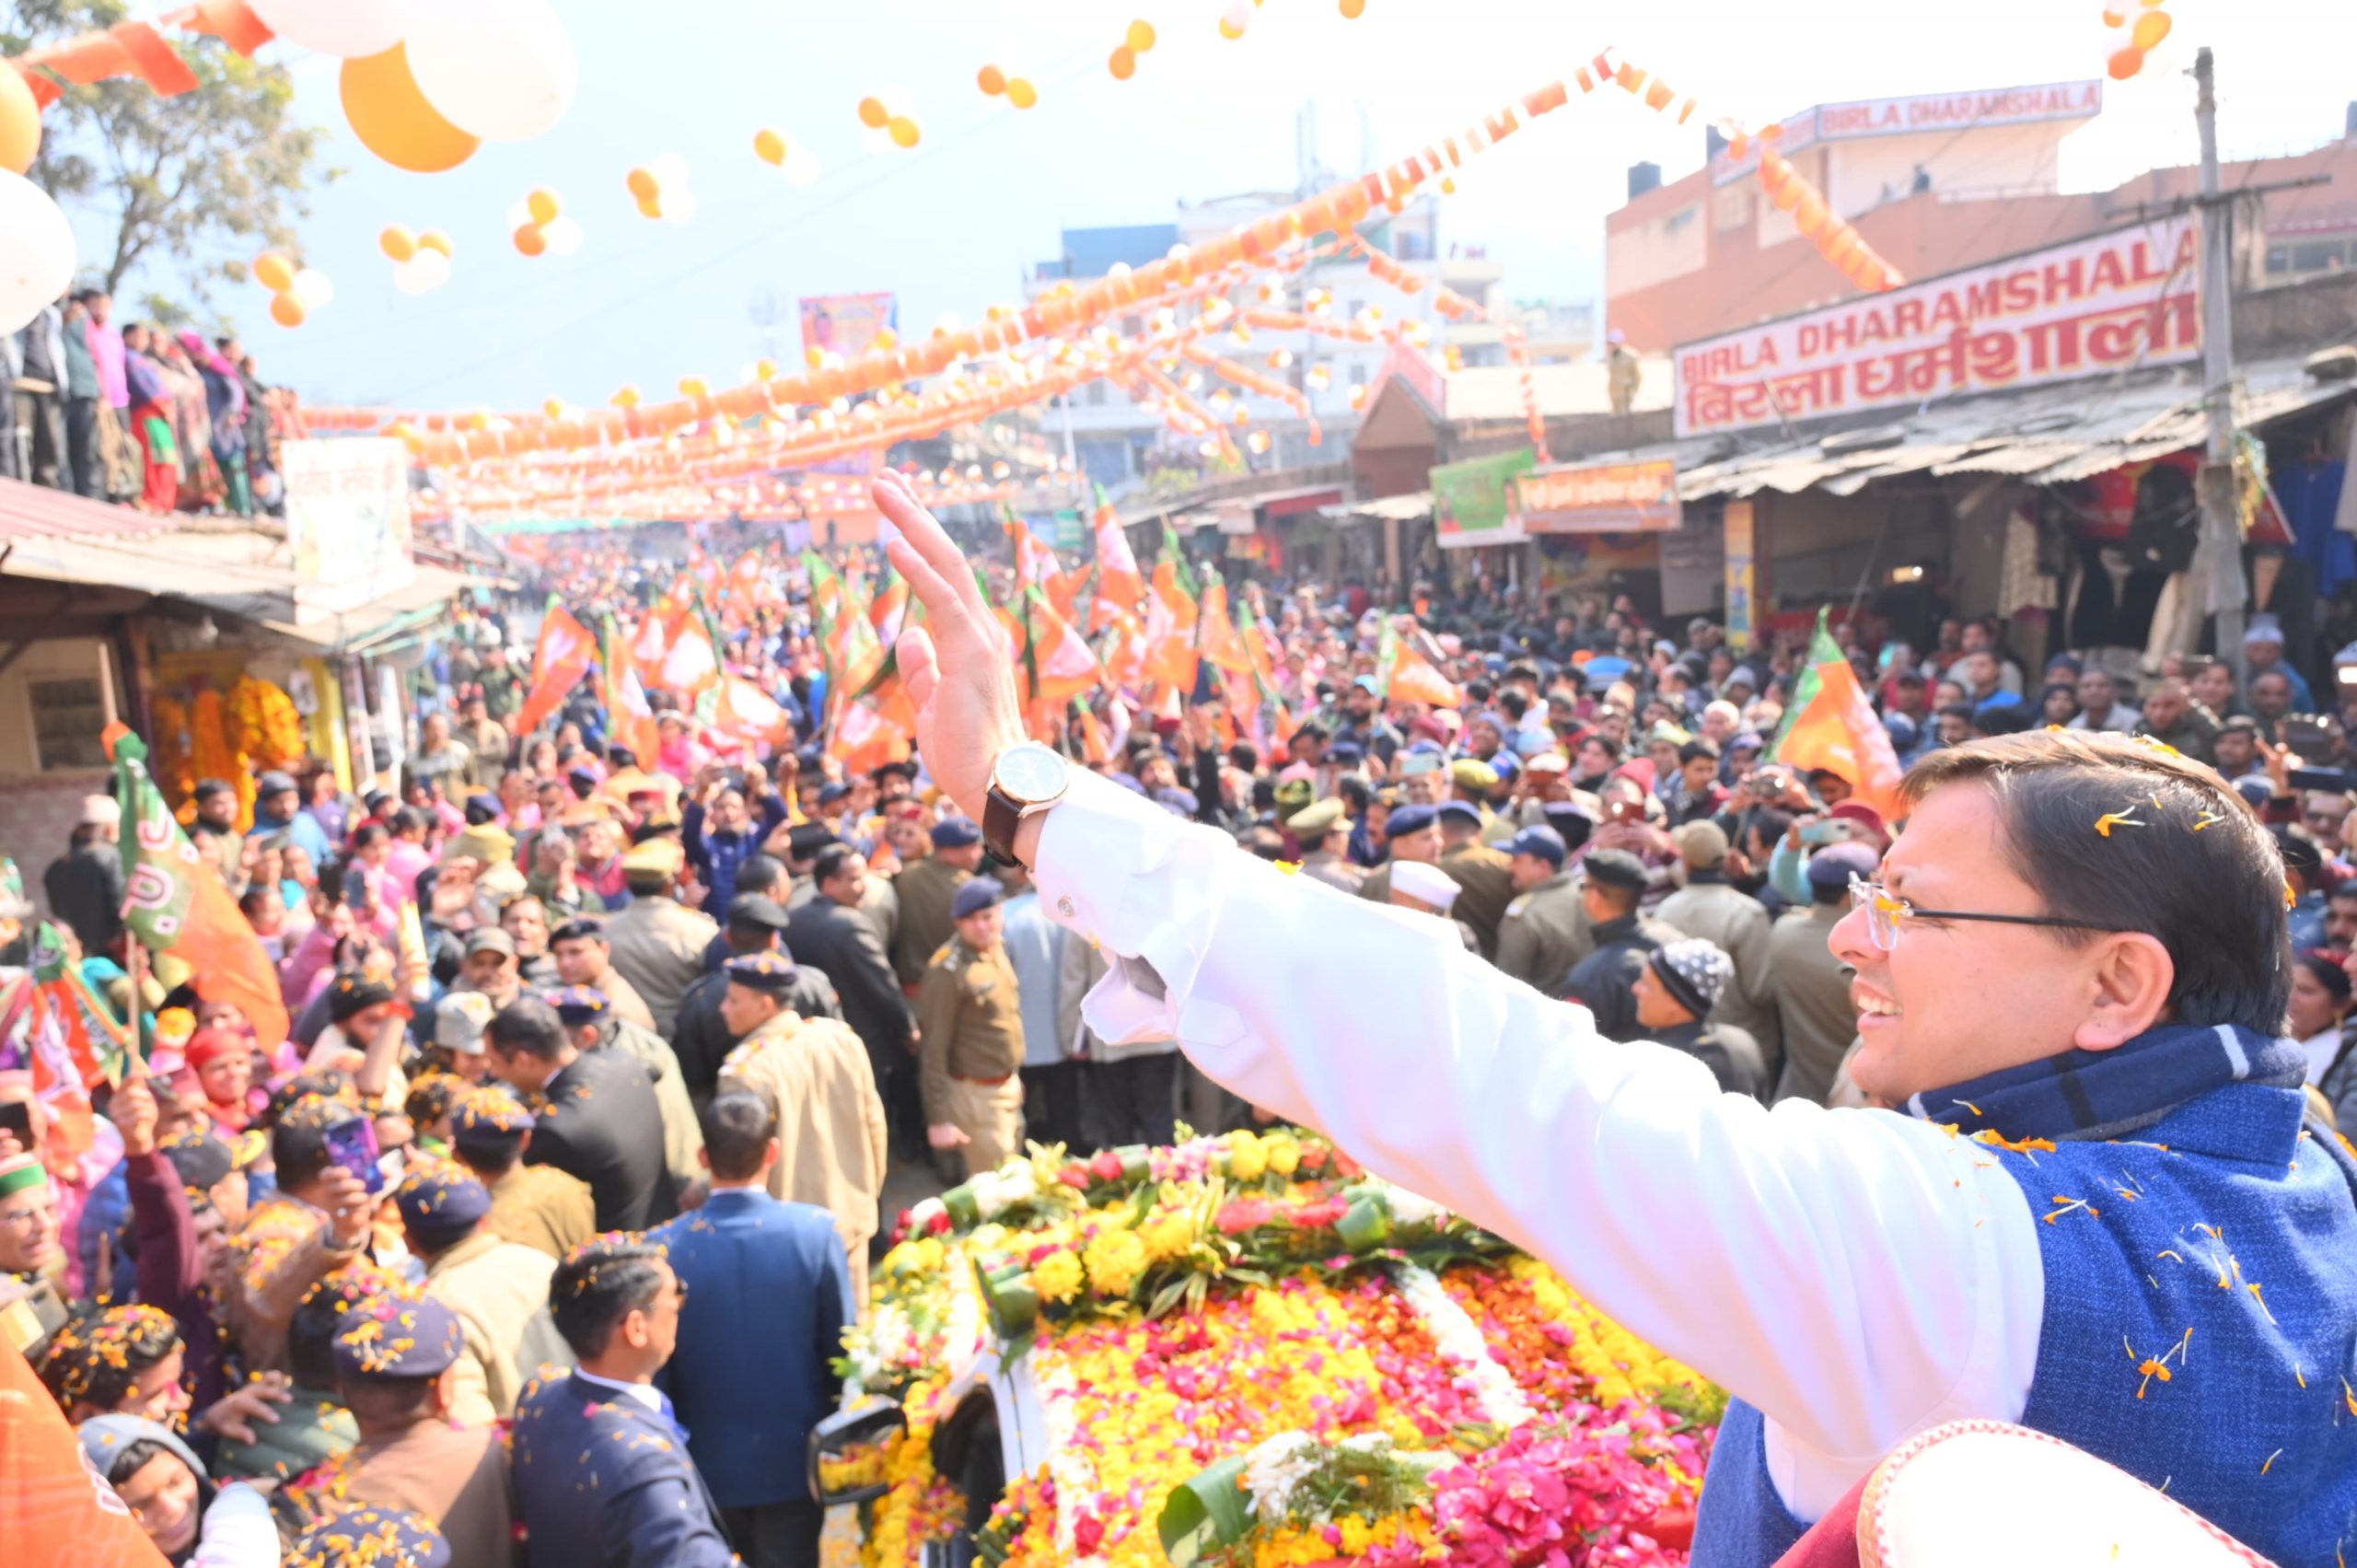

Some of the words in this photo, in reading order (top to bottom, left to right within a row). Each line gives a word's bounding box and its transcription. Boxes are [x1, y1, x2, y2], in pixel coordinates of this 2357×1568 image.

[1824, 104, 1901, 133] BIRLA
[1908, 83, 2098, 125] DHARAMSHALA
[1681, 335, 1778, 384] BIRLA
[1797, 226, 2197, 358] DHARAMSHALA
[1687, 365, 1846, 430] बिरला
[1853, 291, 2197, 402] धर्मशाला
